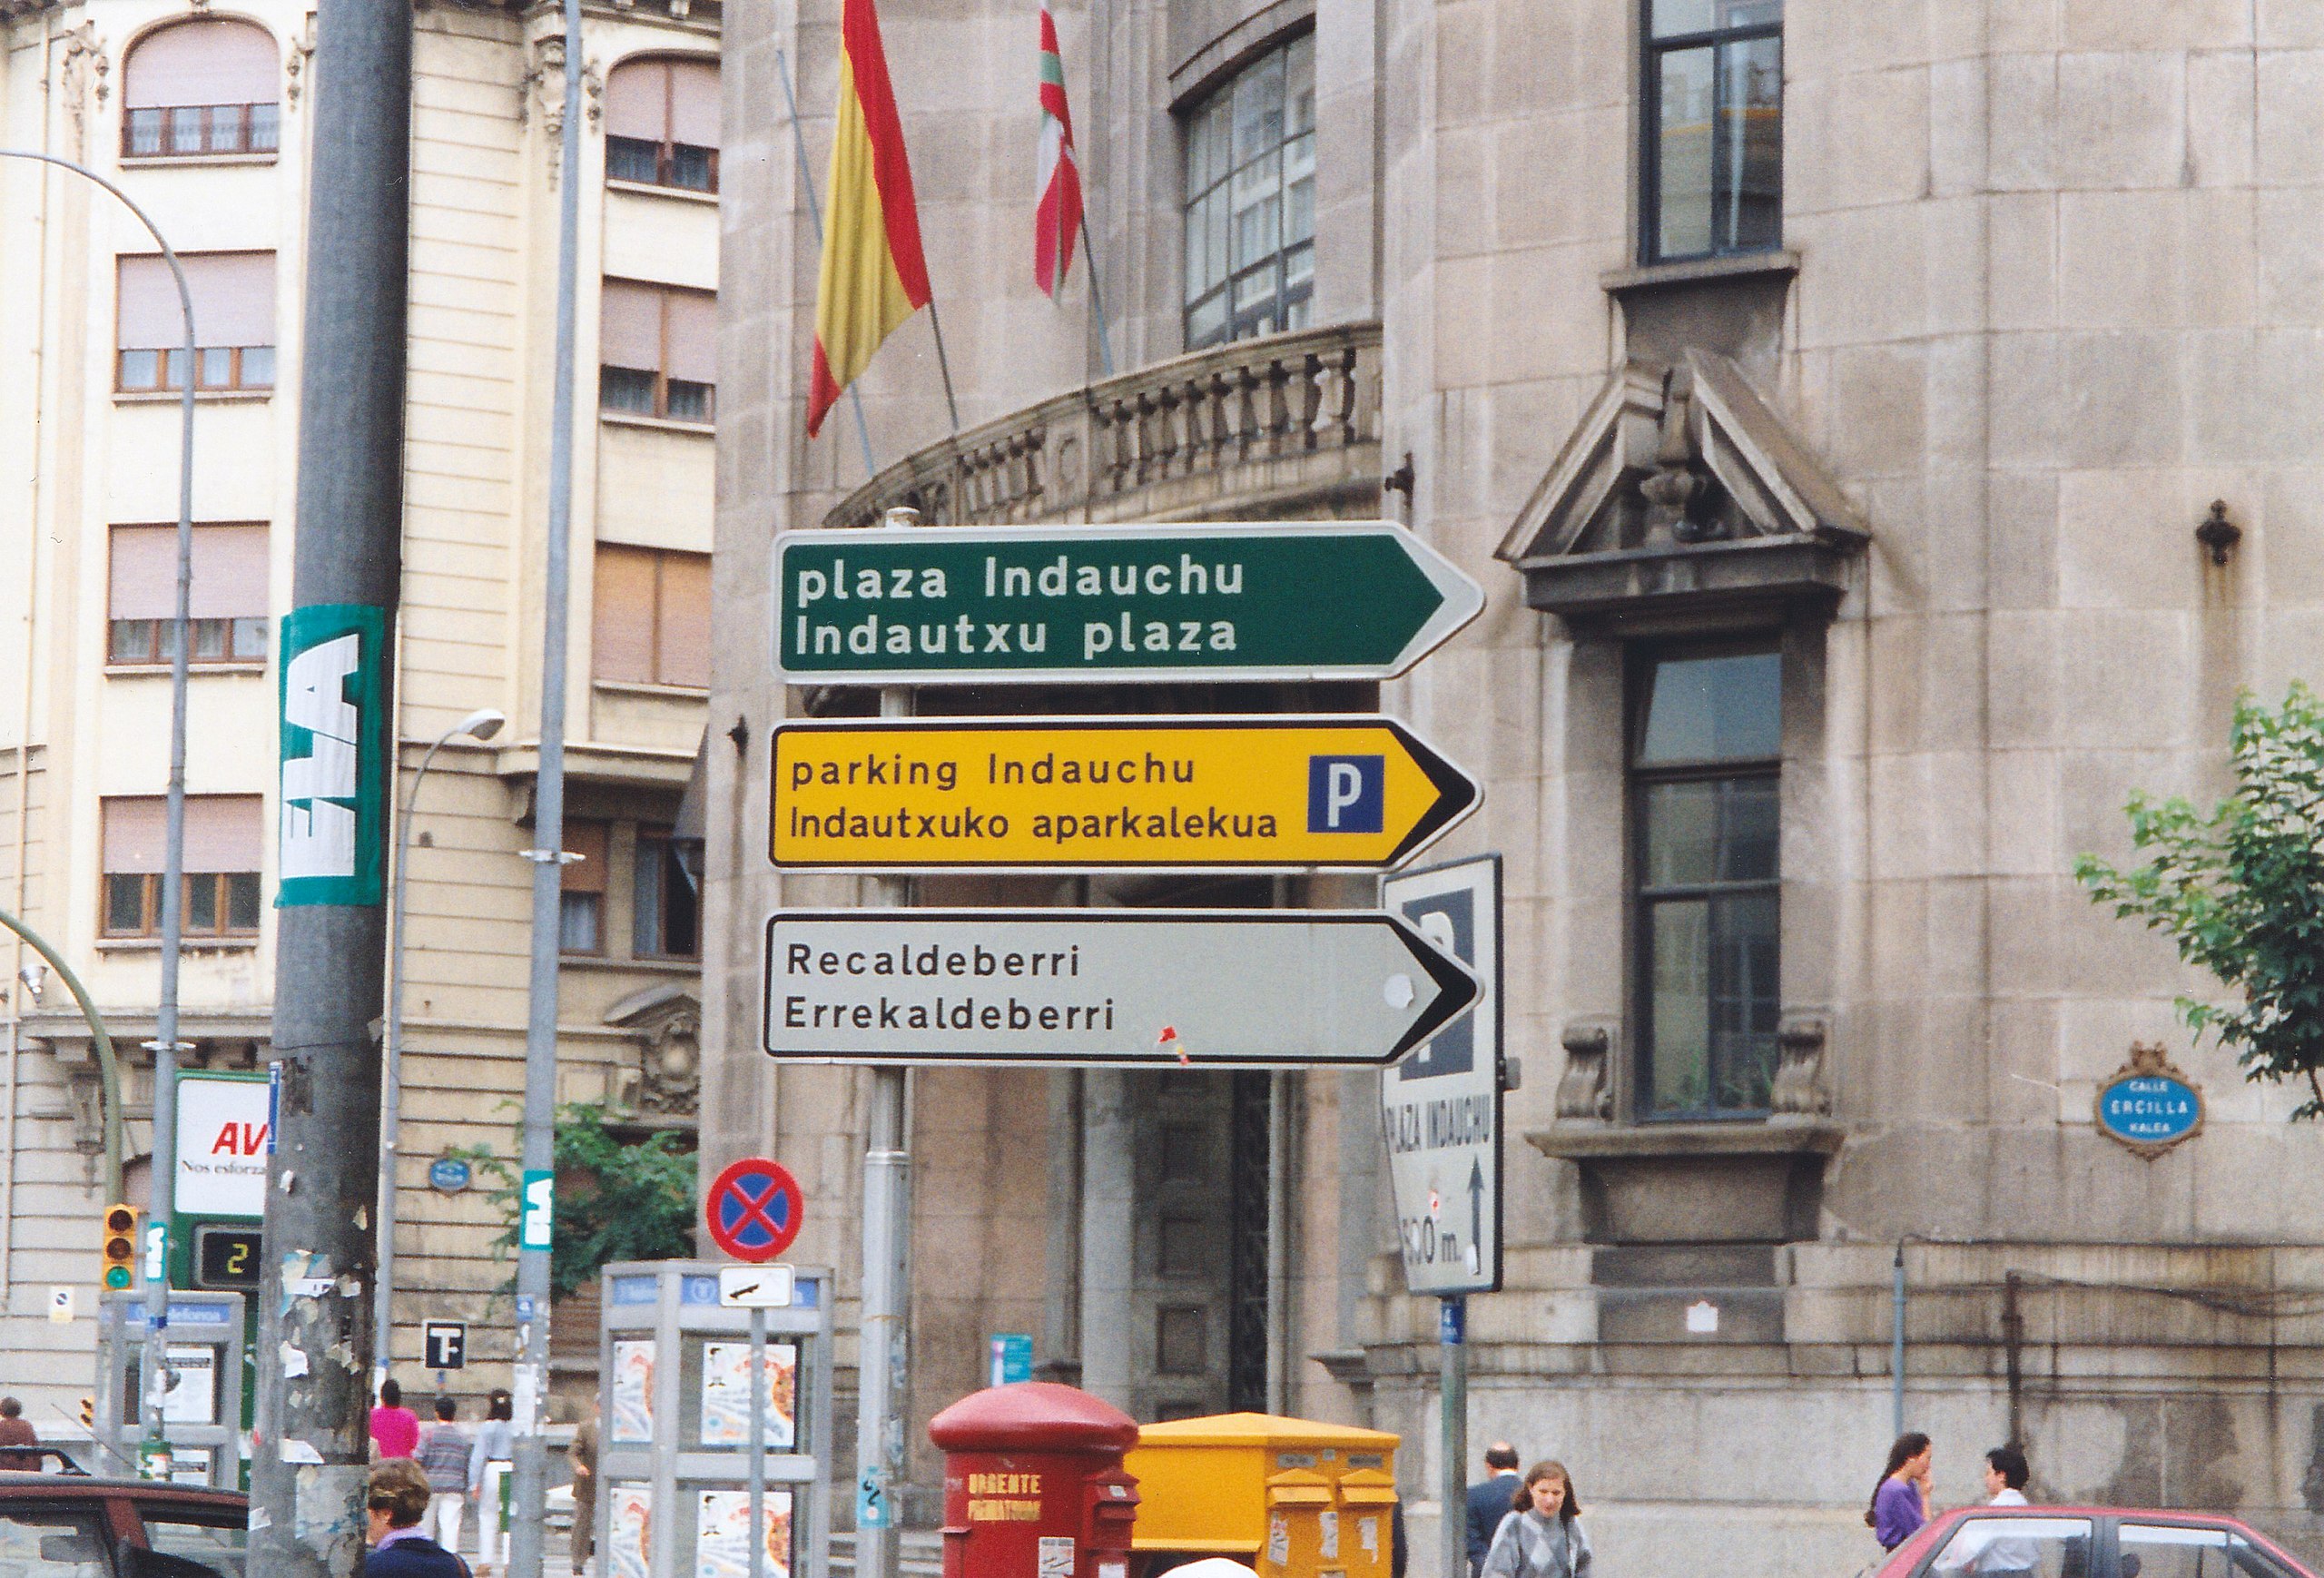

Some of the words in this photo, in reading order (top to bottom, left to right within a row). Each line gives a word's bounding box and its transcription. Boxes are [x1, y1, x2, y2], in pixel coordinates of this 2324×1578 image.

[797, 558, 947, 609] plaza
[985, 553, 1243, 597] Indauchu
[796, 614, 1046, 656] Indautxu
[1084, 611, 1237, 661] plaza
[280, 633, 359, 879] ELA
[792, 753, 957, 792] parking
[989, 752, 1194, 784] Indauchu
[1327, 763, 1363, 828] P
[791, 806, 1009, 839] Indautxuko
[1032, 805, 1277, 845] aparkalekua
[787, 943, 1078, 977] Recaldeberri
[785, 996, 1113, 1031] Errekaldeberri
[2128, 1080, 2169, 1093] CALLE
[2111, 1099, 2189, 1115] ERCILLA
[2129, 1121, 2171, 1134] KALEA
[227, 1243, 249, 1274] 2
